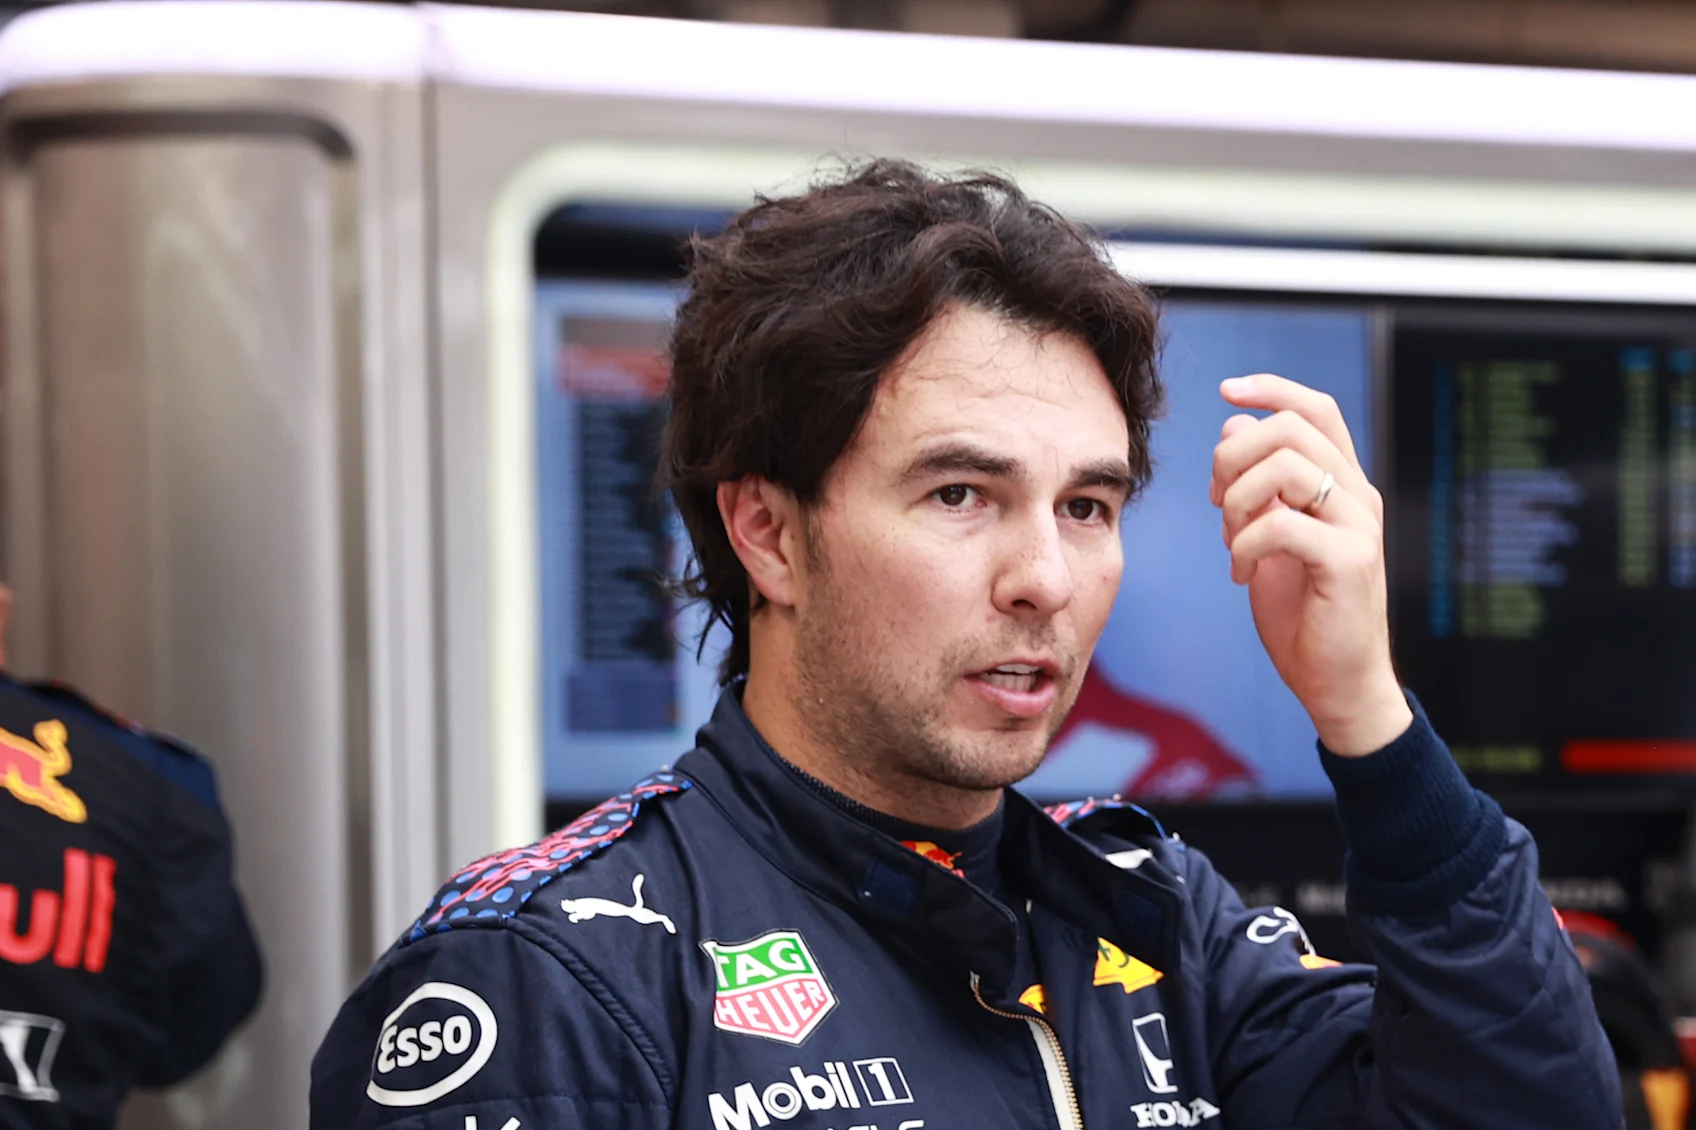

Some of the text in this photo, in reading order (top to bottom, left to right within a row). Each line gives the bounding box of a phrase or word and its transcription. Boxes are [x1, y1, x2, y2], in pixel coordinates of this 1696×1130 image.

[0, 847, 117, 973] ull
[716, 940, 806, 988] TAG
[715, 982, 825, 1036] HEUER
